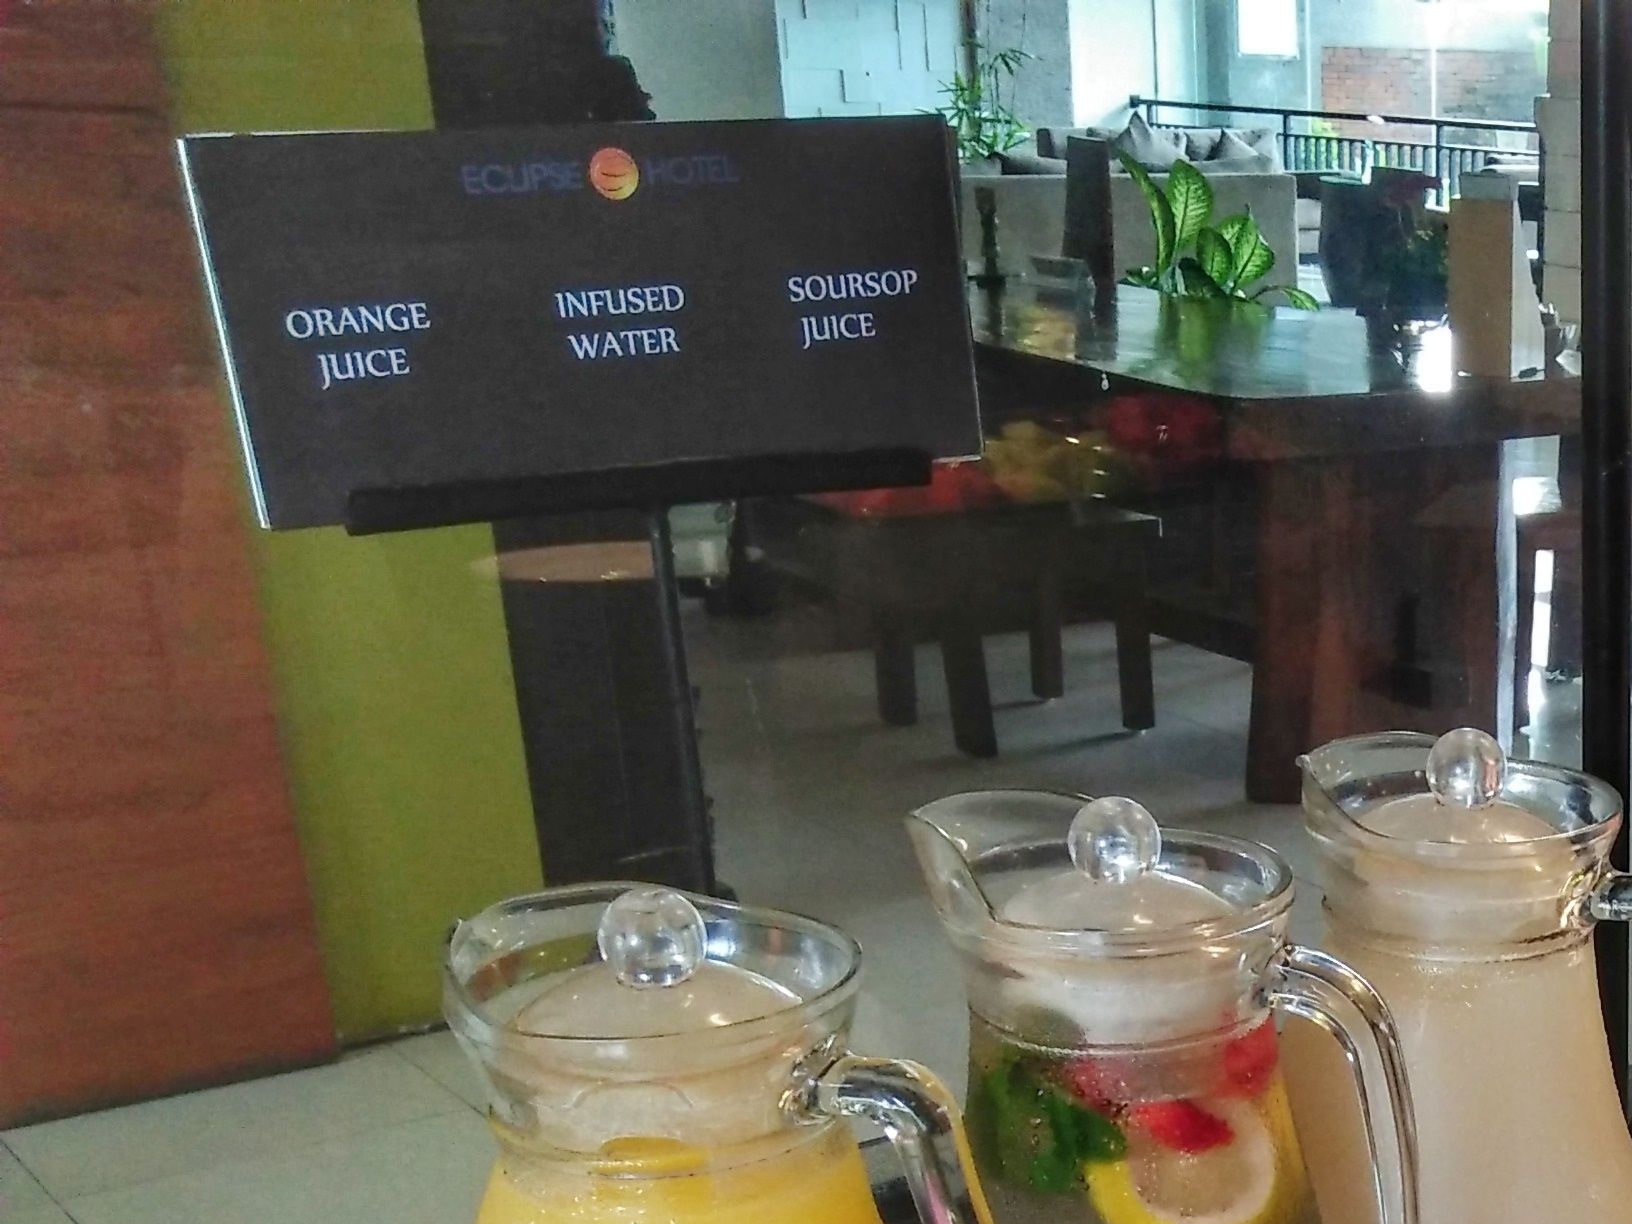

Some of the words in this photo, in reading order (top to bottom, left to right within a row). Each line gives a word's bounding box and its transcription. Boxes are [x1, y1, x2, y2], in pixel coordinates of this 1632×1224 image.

[460, 162, 583, 194] ECLIPSE
[645, 154, 740, 185] HOTEL
[554, 284, 685, 319] INFUSED
[788, 269, 918, 303] SOURSOP
[285, 301, 431, 340] ORANGE
[799, 311, 876, 350] JUICE
[566, 326, 681, 361] WATER
[317, 347, 411, 391] JUICE
